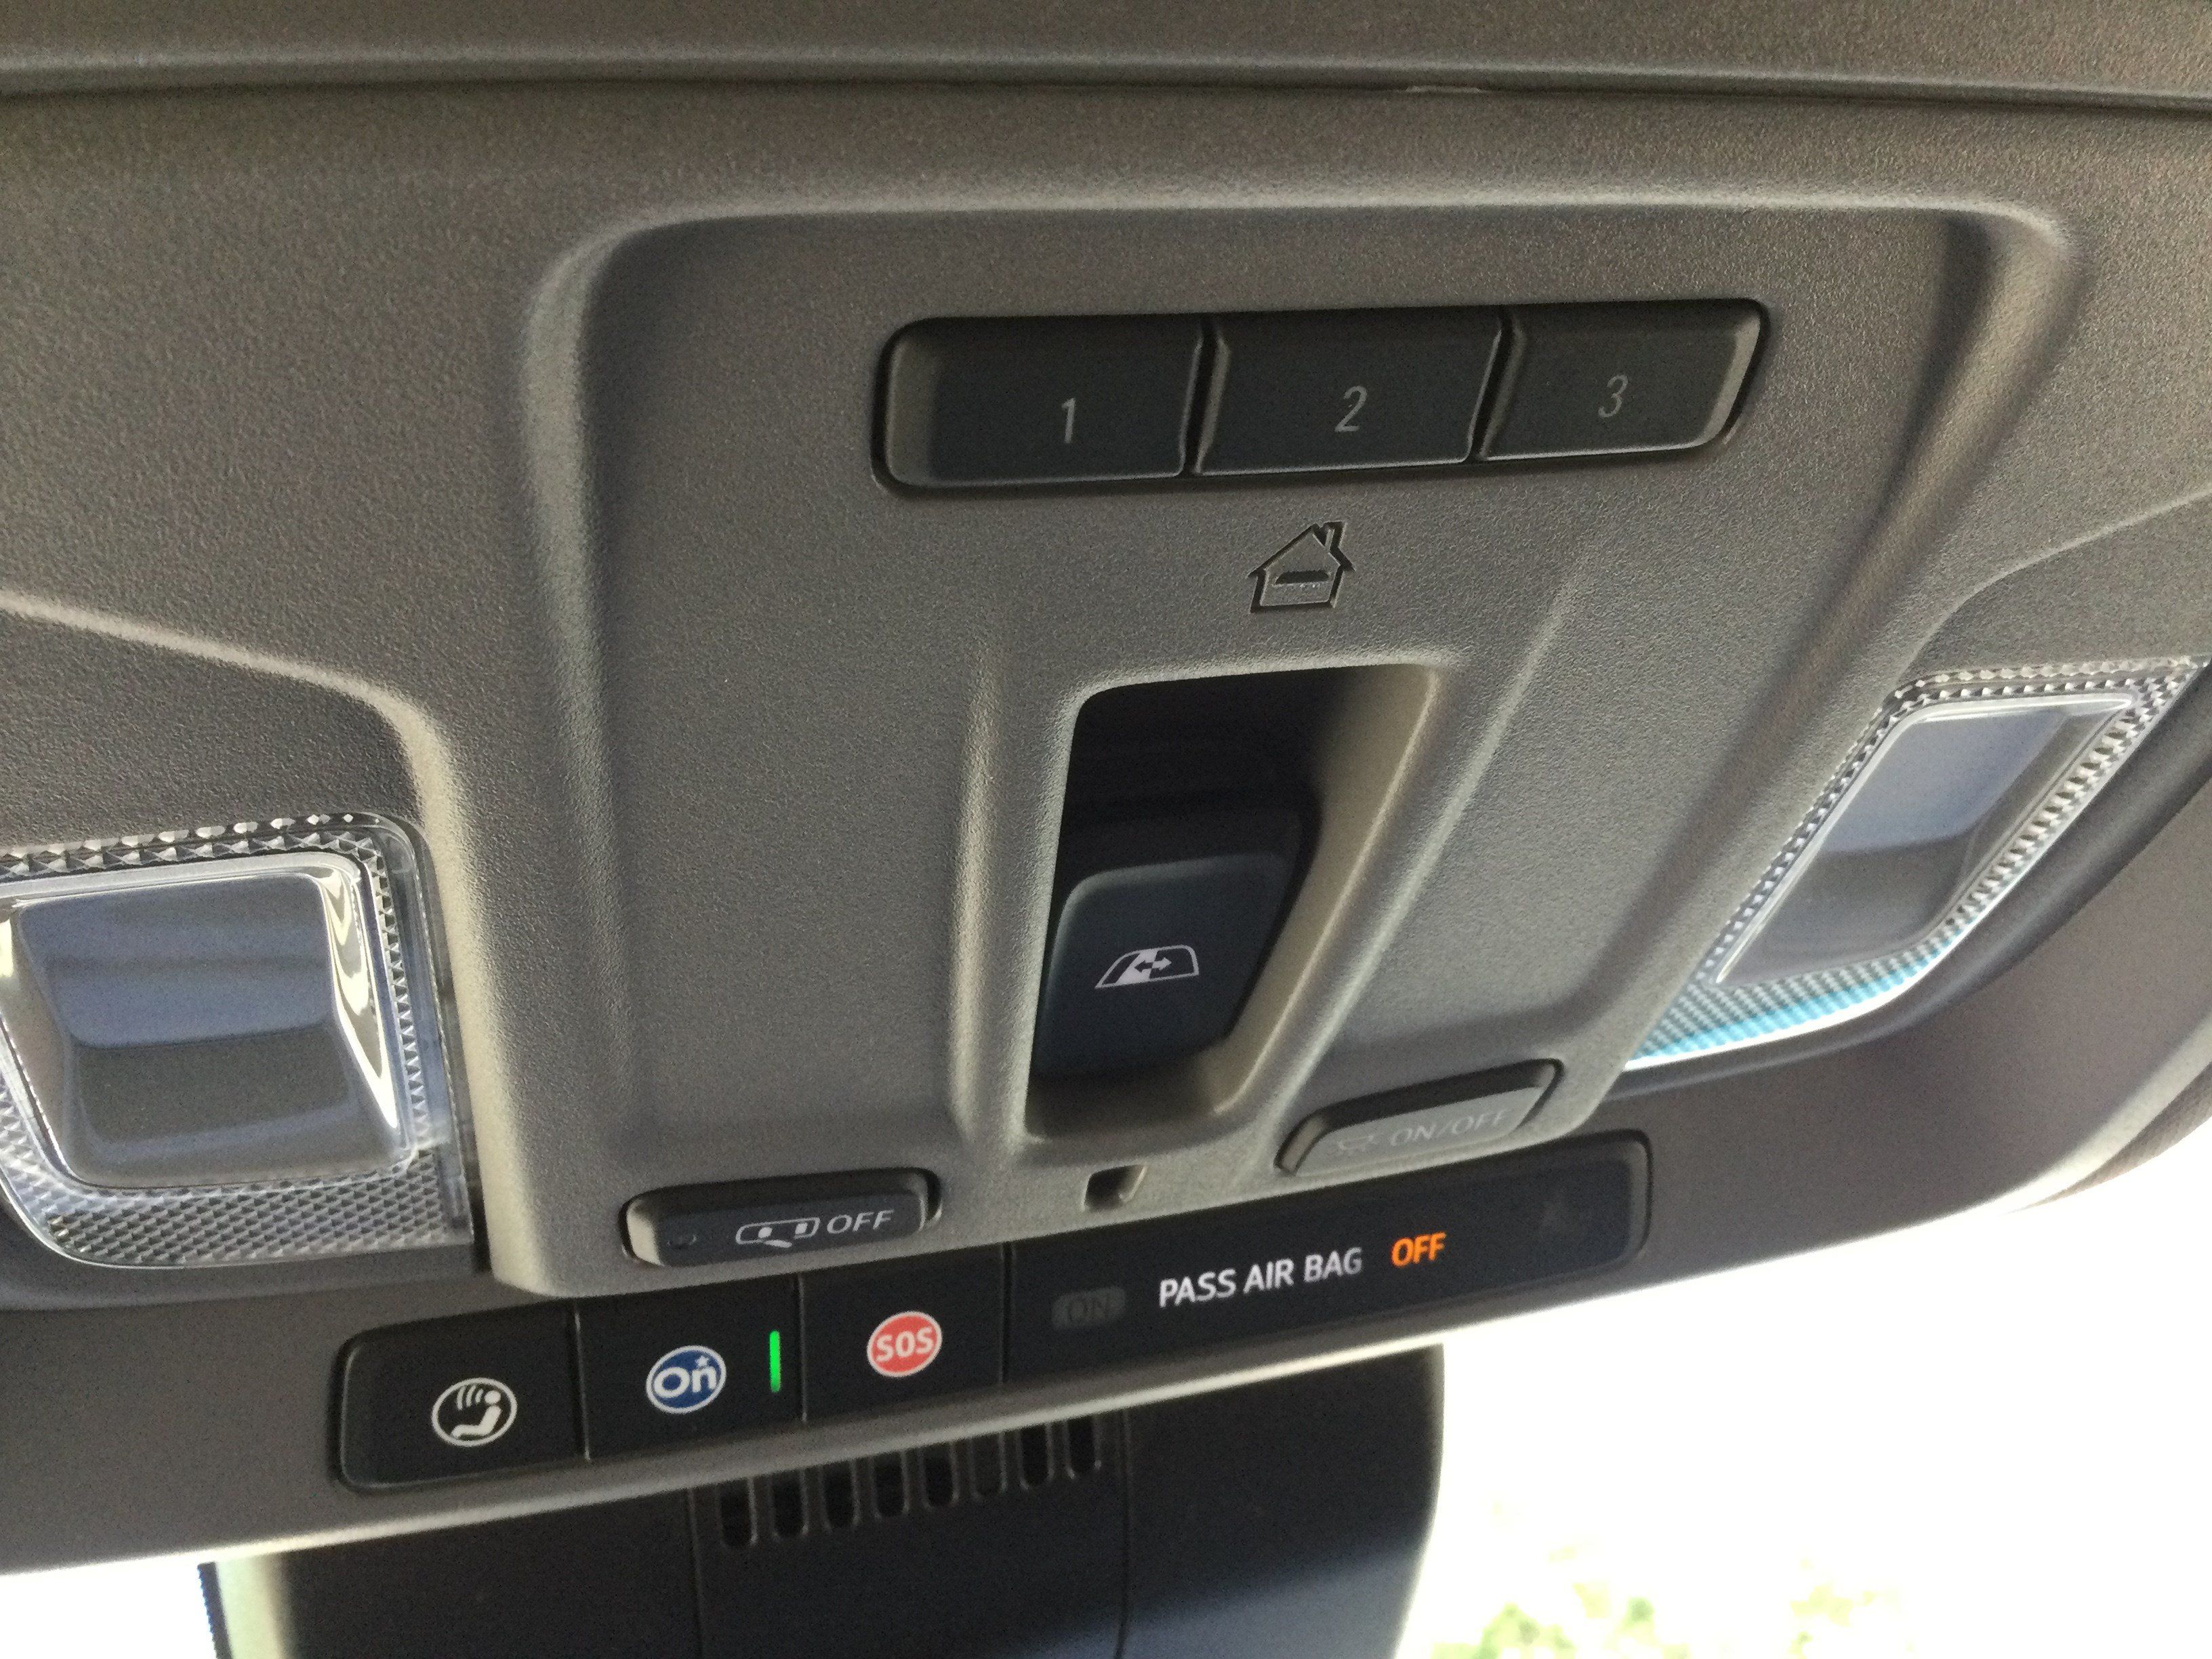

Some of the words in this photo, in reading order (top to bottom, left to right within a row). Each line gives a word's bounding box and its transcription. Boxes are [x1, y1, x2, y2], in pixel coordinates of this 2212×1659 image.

[1334, 385, 1368, 432] 2
[1598, 375, 1628, 419] 3
[1061, 397, 1076, 443] 1
[1389, 1109, 1513, 1147] ON/OFF
[826, 1209, 895, 1234] OFF
[1159, 1268, 1237, 1308] PASS
[1243, 1257, 1294, 1295] AIR
[1303, 1246, 1363, 1283] BAG
[1390, 1231, 1447, 1267] OFF
[875, 1326, 934, 1362] SOS
[653, 1364, 718, 1399] On
